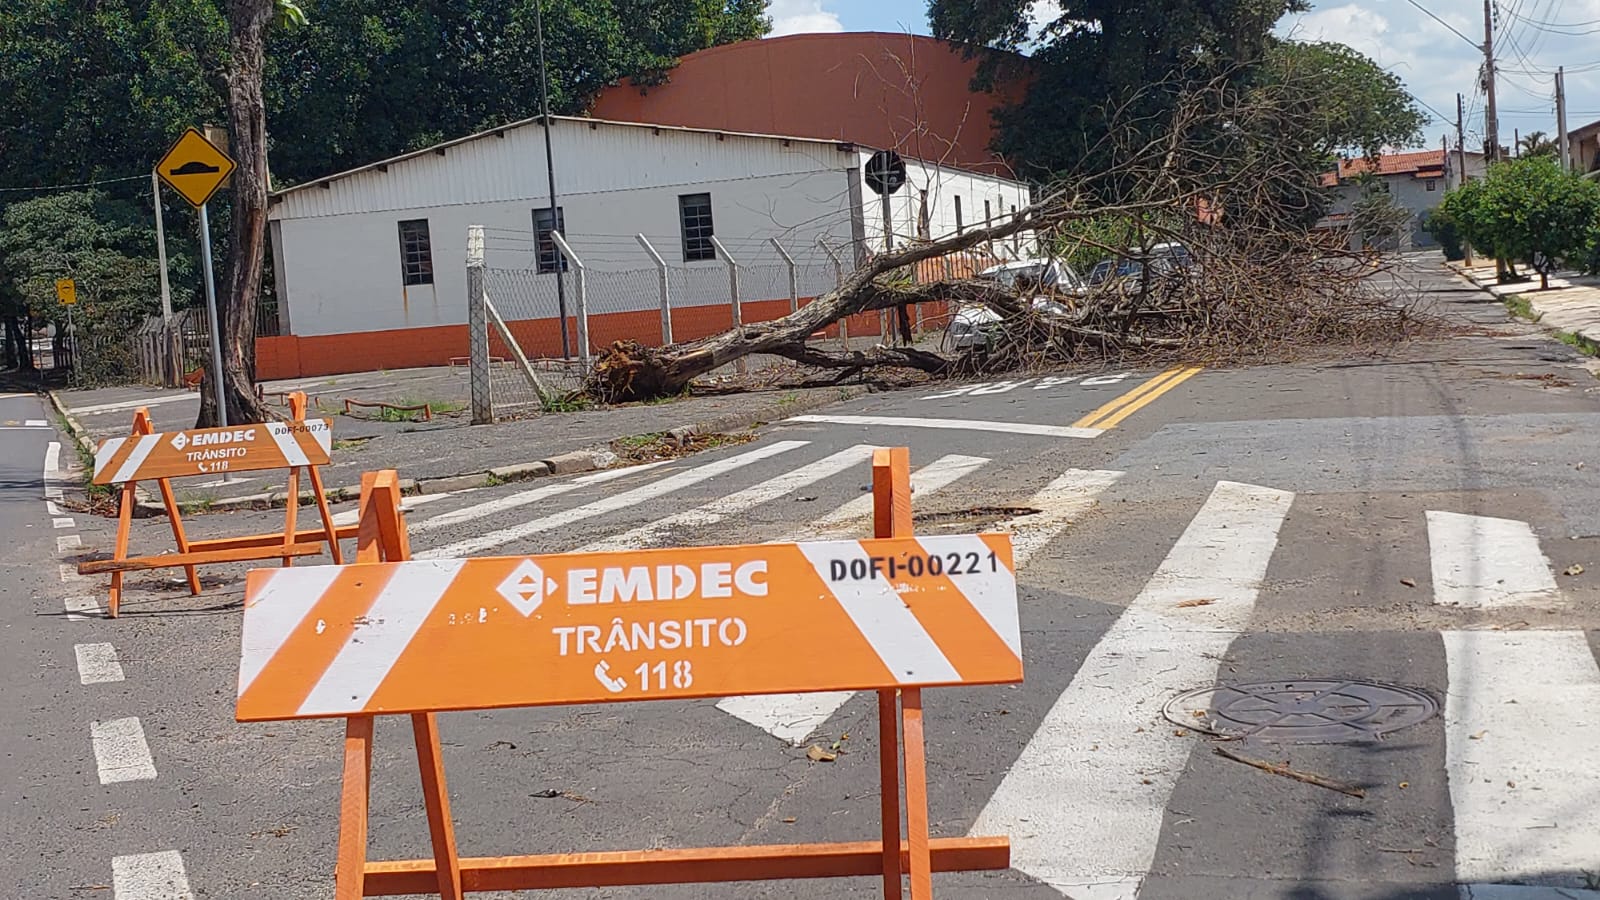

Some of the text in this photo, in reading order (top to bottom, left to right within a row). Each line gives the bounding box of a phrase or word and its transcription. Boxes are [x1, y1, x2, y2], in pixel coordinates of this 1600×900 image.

[192, 429, 256, 447] EMDEC
[186, 447, 247, 462] TRÂNSITO
[210, 461, 229, 472] 118
[568, 560, 768, 605] EMDEC
[552, 617, 747, 656] TRÂNSITO
[634, 660, 693, 691] 118
